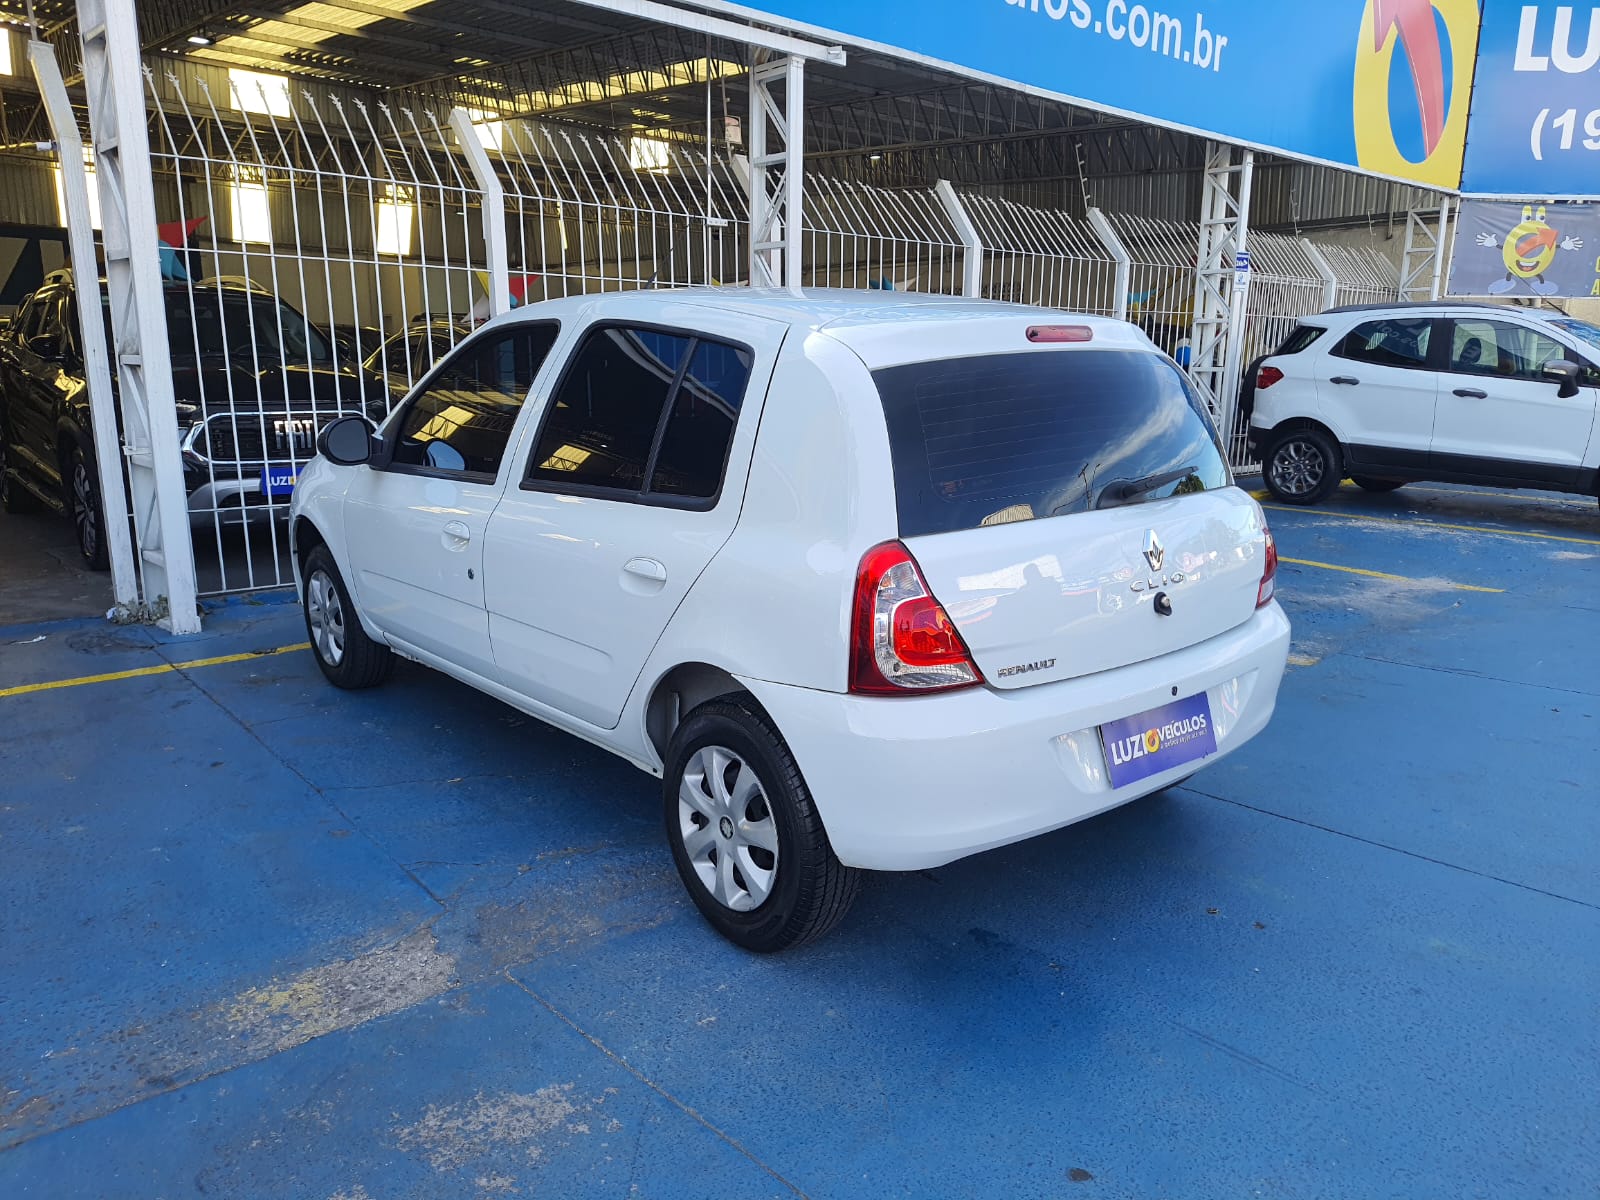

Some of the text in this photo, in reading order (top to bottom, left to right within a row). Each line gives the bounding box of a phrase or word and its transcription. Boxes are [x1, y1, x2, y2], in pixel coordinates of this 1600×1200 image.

[273, 419, 313, 450] FIAT
[267, 475, 296, 487] UZI
[1130, 571, 1184, 592] CLIO
[997, 658, 1057, 679] RENAULT
[1157, 713, 1207, 742] VEÍCULOS
